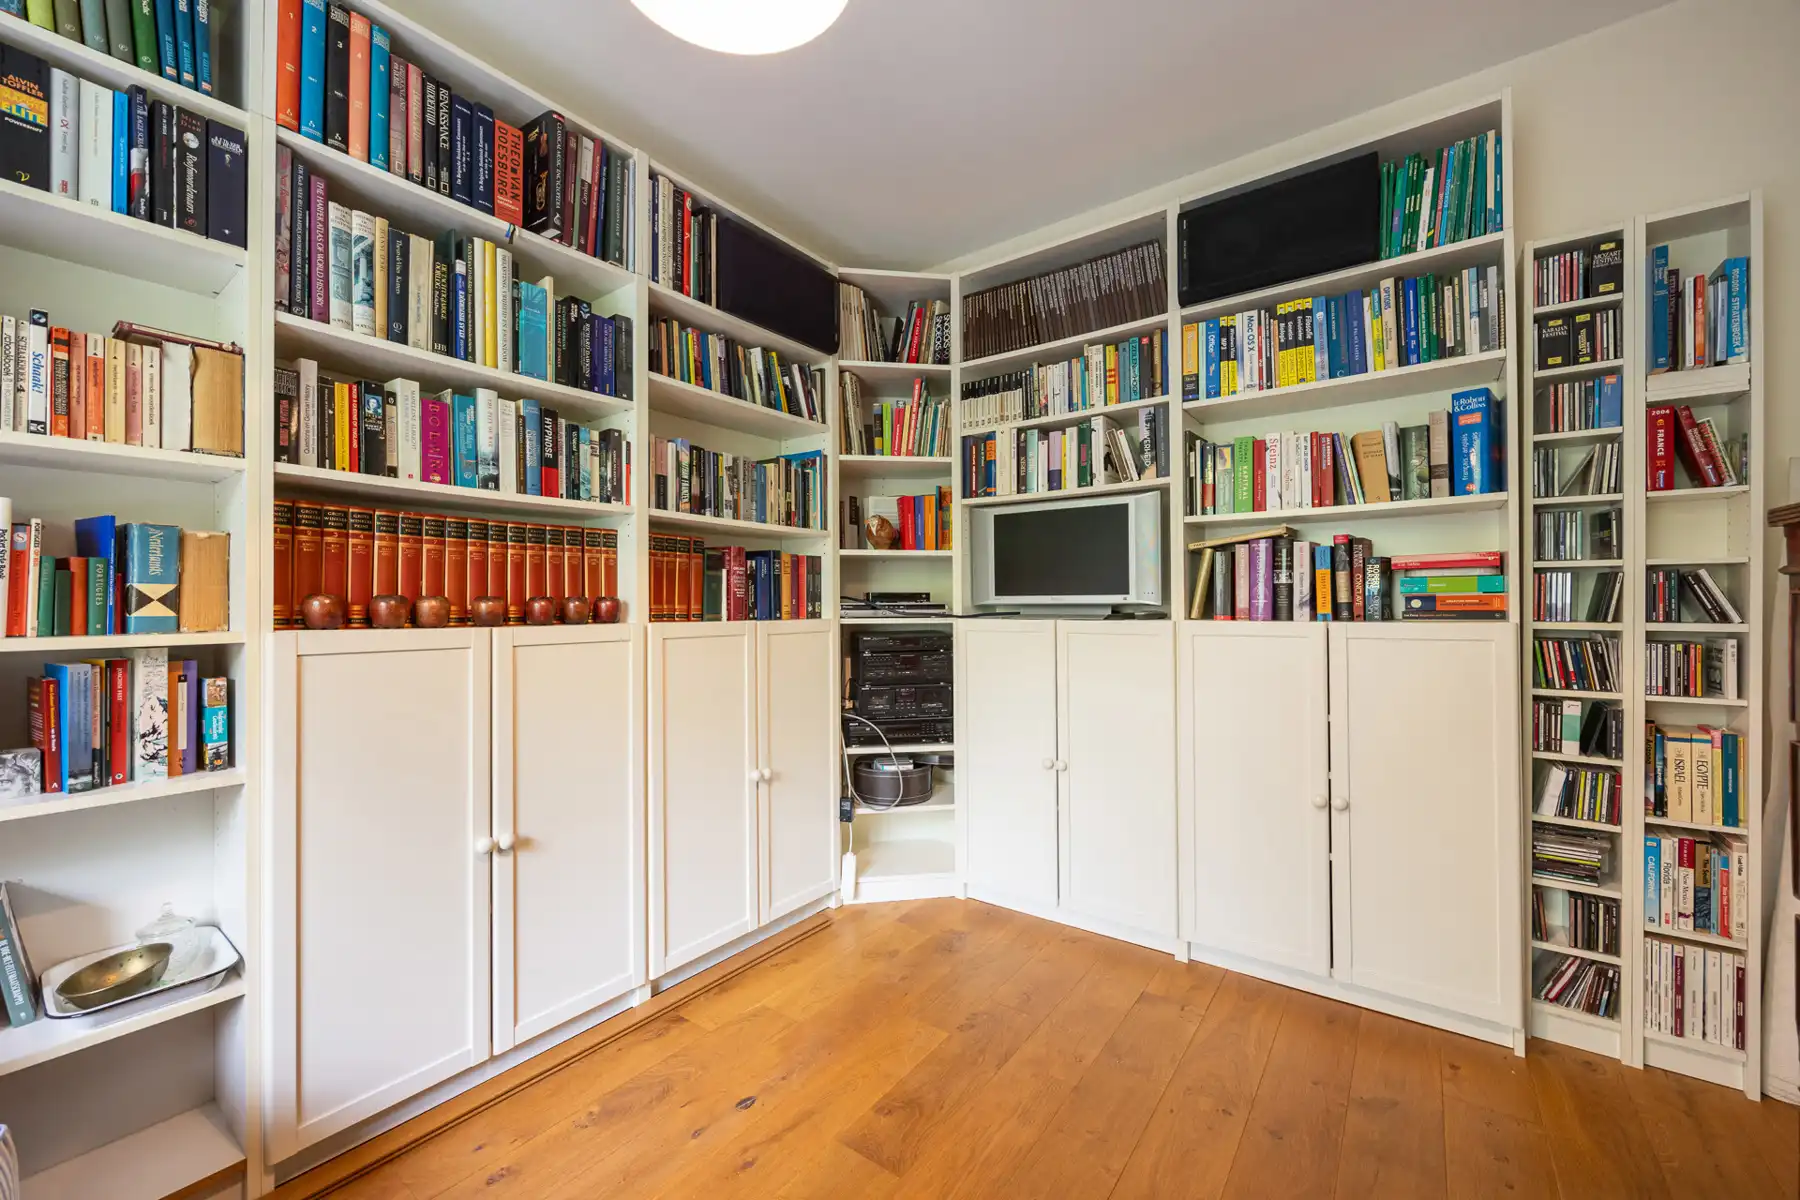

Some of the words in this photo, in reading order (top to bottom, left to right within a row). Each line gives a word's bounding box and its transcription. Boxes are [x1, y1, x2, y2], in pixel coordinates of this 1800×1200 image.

[426, 82, 436, 126] RIDDERTIJD
[439, 87, 449, 149] RENAISSANCE
[497, 126, 508, 195] DOESBURG
[510, 132, 520, 168] THEO
[183, 152, 197, 214] Roofmoordenaars
[317, 181, 325, 196] THE
[511, 176, 520, 202] VAN
[1731, 297, 1741, 348] STRATENBOEK
[3, 333, 14, 376] schaakboek
[1247, 334, 1255, 346] OS
[17, 336, 27, 384] SCHAAKBOEK
[32, 351, 44, 394] Schaak!
[17, 384, 26, 394] 4
[1460, 401, 1486, 412] Collins
[544, 417, 553, 459] HYPNOSE
[1269, 438, 1279, 470] Steinz
[1462, 457, 1470, 481] français
[149, 532, 165, 576] Nederlands
[1645, 738, 1653, 765] Arizona
[1674, 758, 1686, 784] ISRAEL
[1696, 760, 1709, 790] EGYPTE
[1663, 862, 1672, 885] Florida
